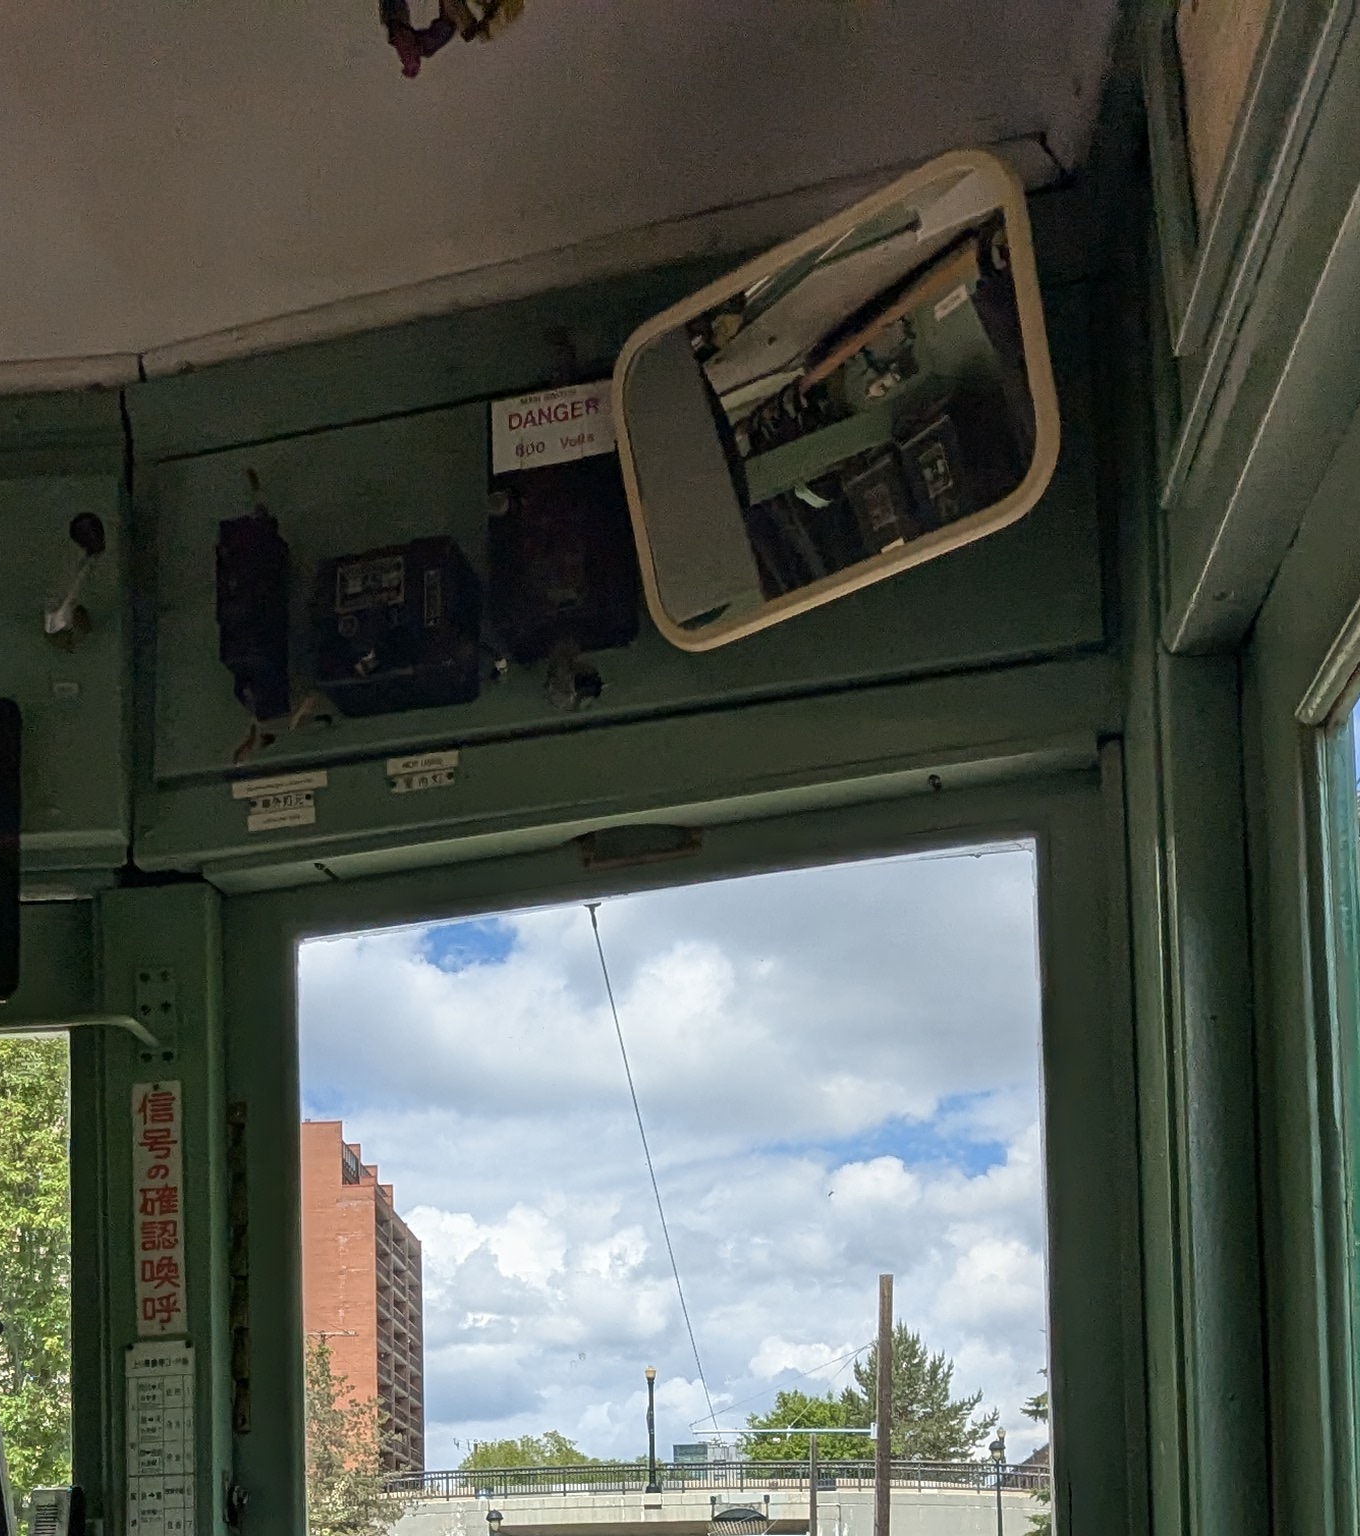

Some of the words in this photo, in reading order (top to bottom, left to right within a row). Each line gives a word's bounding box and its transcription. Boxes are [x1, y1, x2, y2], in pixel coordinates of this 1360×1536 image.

[508, 397, 600, 431] DANGER
[138, 1090, 181, 1324] 信号の確認喚呼
